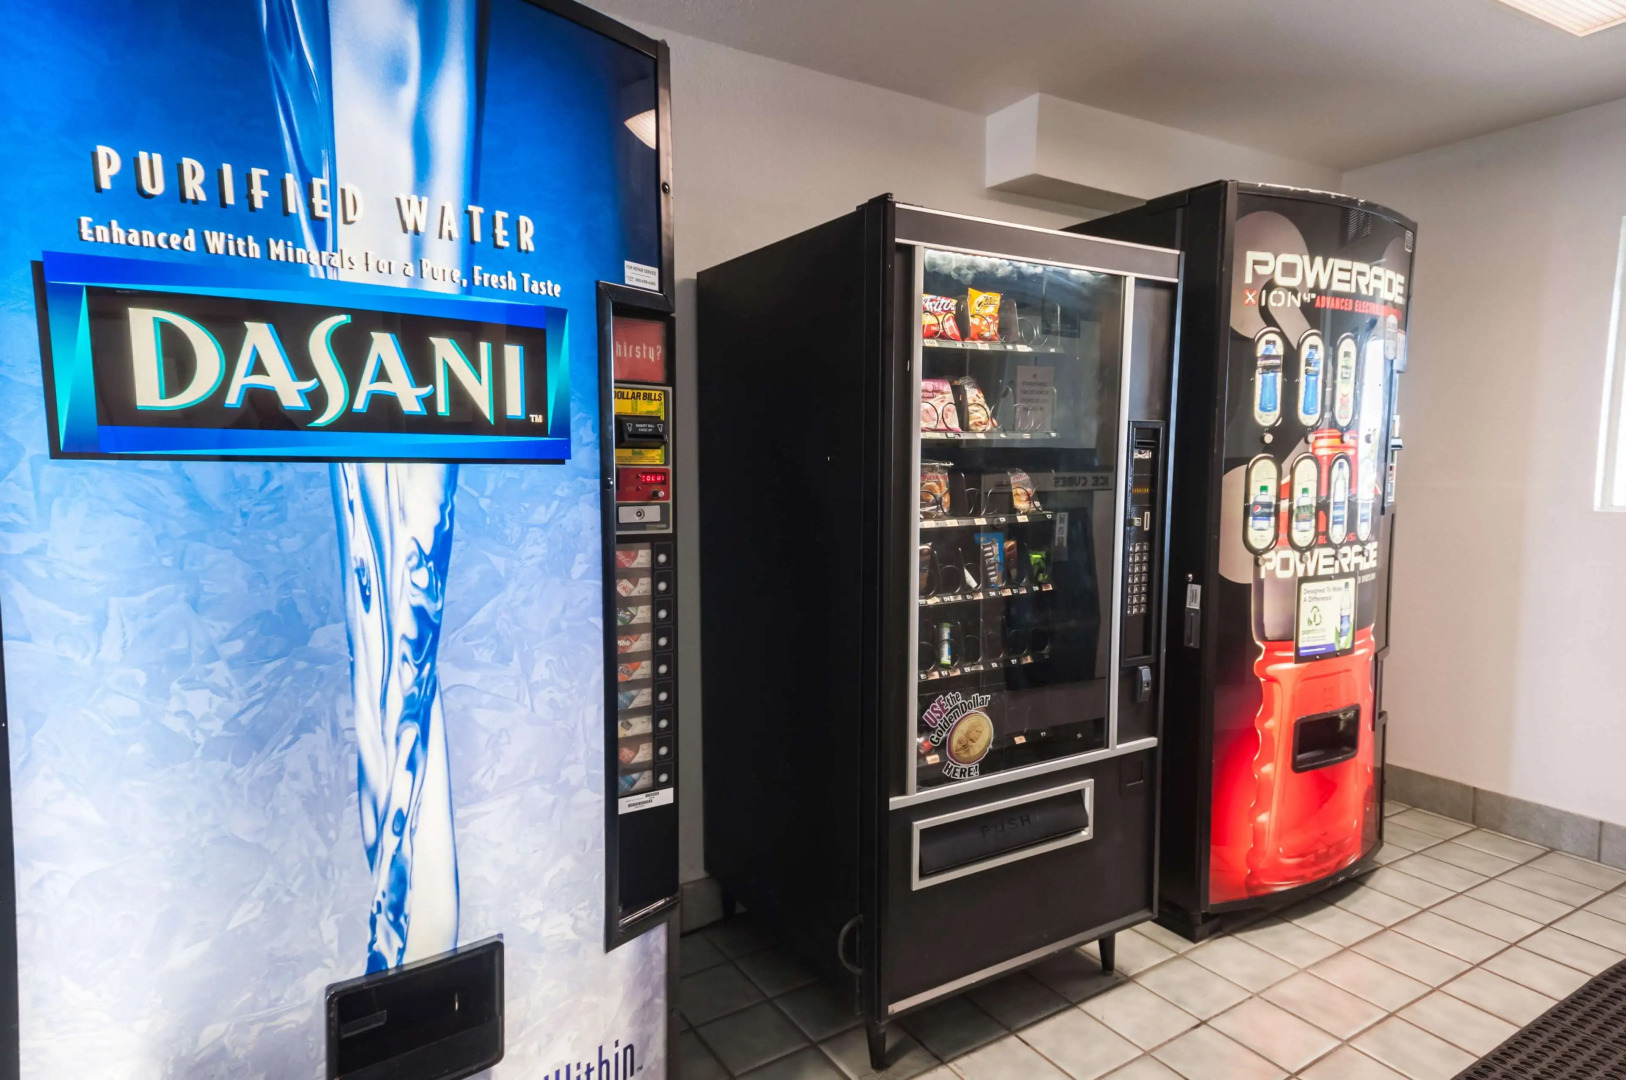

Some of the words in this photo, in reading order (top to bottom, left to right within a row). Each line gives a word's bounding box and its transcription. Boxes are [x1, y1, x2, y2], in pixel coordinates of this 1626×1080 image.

[91, 145, 364, 225] PURIFIED
[395, 193, 535, 254] WATER
[78, 215, 196, 252] Enhanced
[202, 229, 261, 259] With
[266, 237, 355, 270] Minerals
[364, 251, 396, 274] For
[403, 260, 415, 278] a
[418, 256, 468, 288] Pure,
[472, 265, 517, 292] Fresh
[520, 272, 562, 298] Taste
[1244, 250, 1407, 305] POWERADE
[1314, 294, 1353, 312] ADVANCED
[128, 307, 524, 427] DASANI
[643, 392, 663, 402] BILLS
[1259, 541, 1379, 579] POWERADE
[922, 695, 949, 728] USE
[945, 692, 961, 708] the
[929, 707, 961, 746] Golden
[960, 693, 990, 715] Dollar
[943, 761, 979, 778] HERE!
[980, 814, 1032, 838] PUSH
